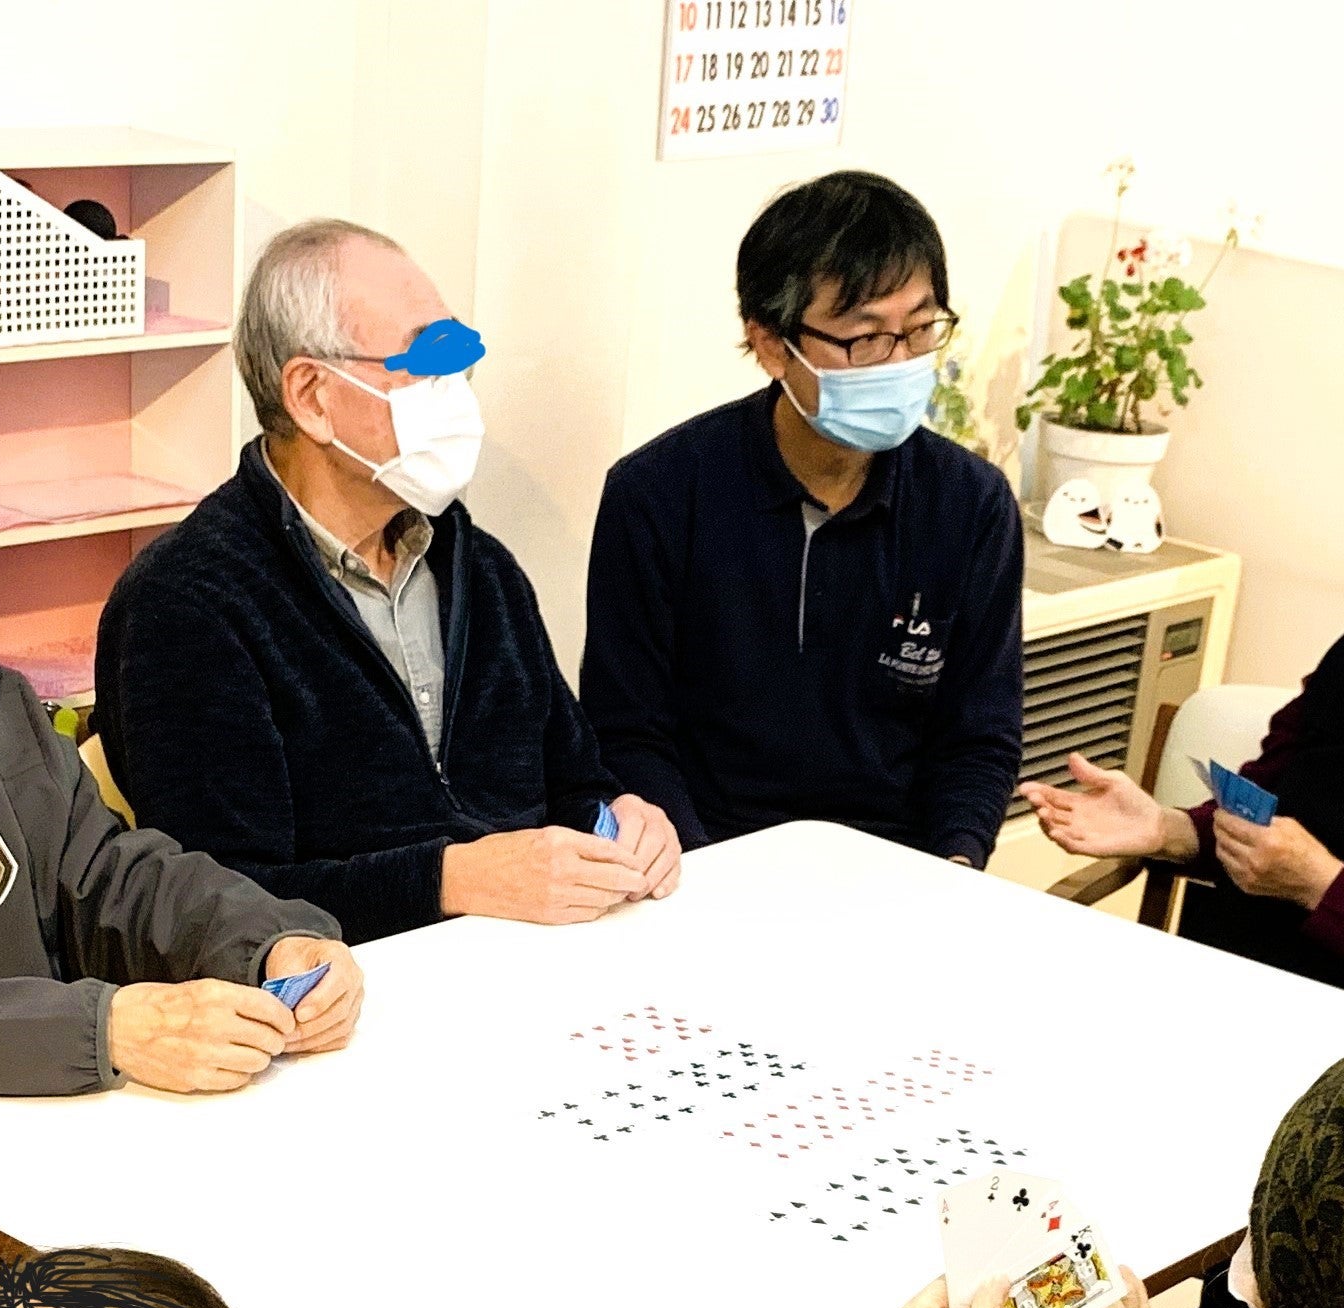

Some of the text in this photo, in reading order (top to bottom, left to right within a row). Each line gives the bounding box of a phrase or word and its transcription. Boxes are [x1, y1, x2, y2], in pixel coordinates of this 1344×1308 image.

[680, 0, 846, 31] 10 11 12 13 14 15 16
[676, 48, 843, 82] 17 18 19 20 21 22 23
[671, 97, 839, 135] 24 25 26 27 28 29 30
[990, 1175, 1000, 1190] 2
[942, 1198, 950, 1214] A
